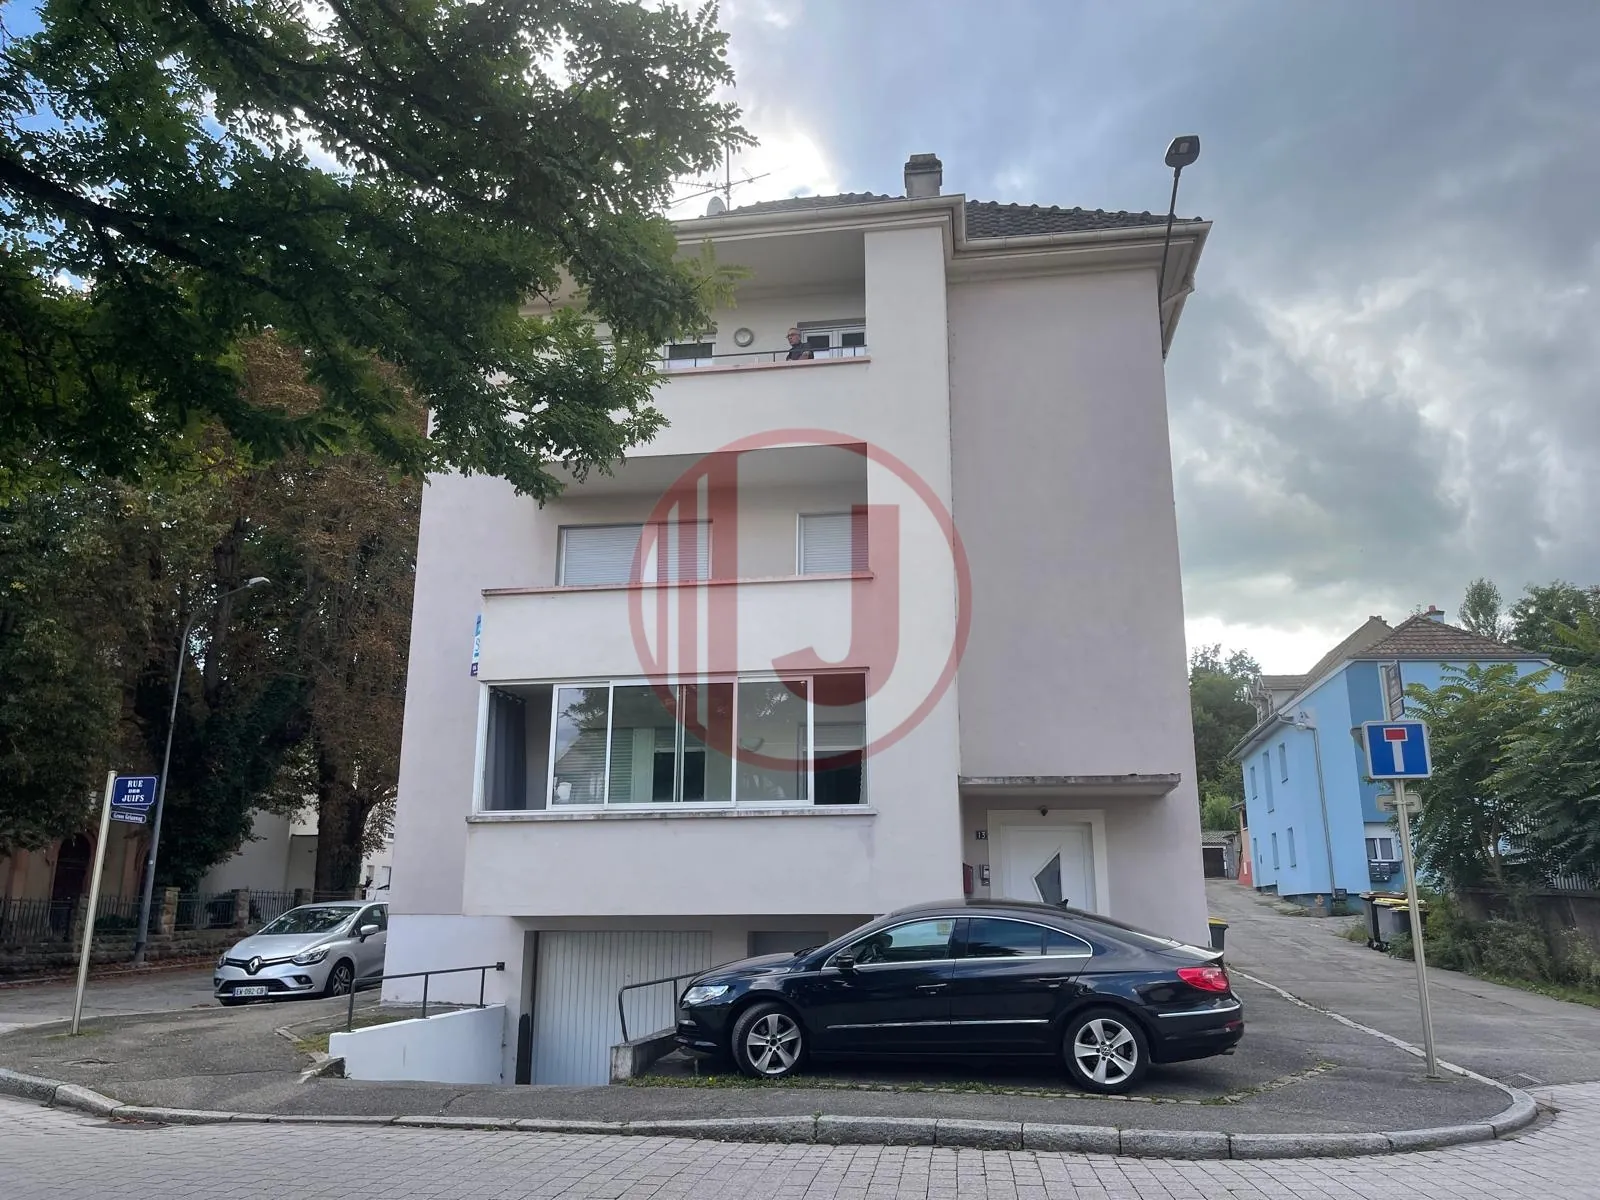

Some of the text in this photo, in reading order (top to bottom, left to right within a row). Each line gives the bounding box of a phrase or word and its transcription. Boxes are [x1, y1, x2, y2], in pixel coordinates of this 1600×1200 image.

[127, 780, 144, 788] RUE
[121, 794, 145, 802] JUIFS
[978, 831, 986, 839] 13
